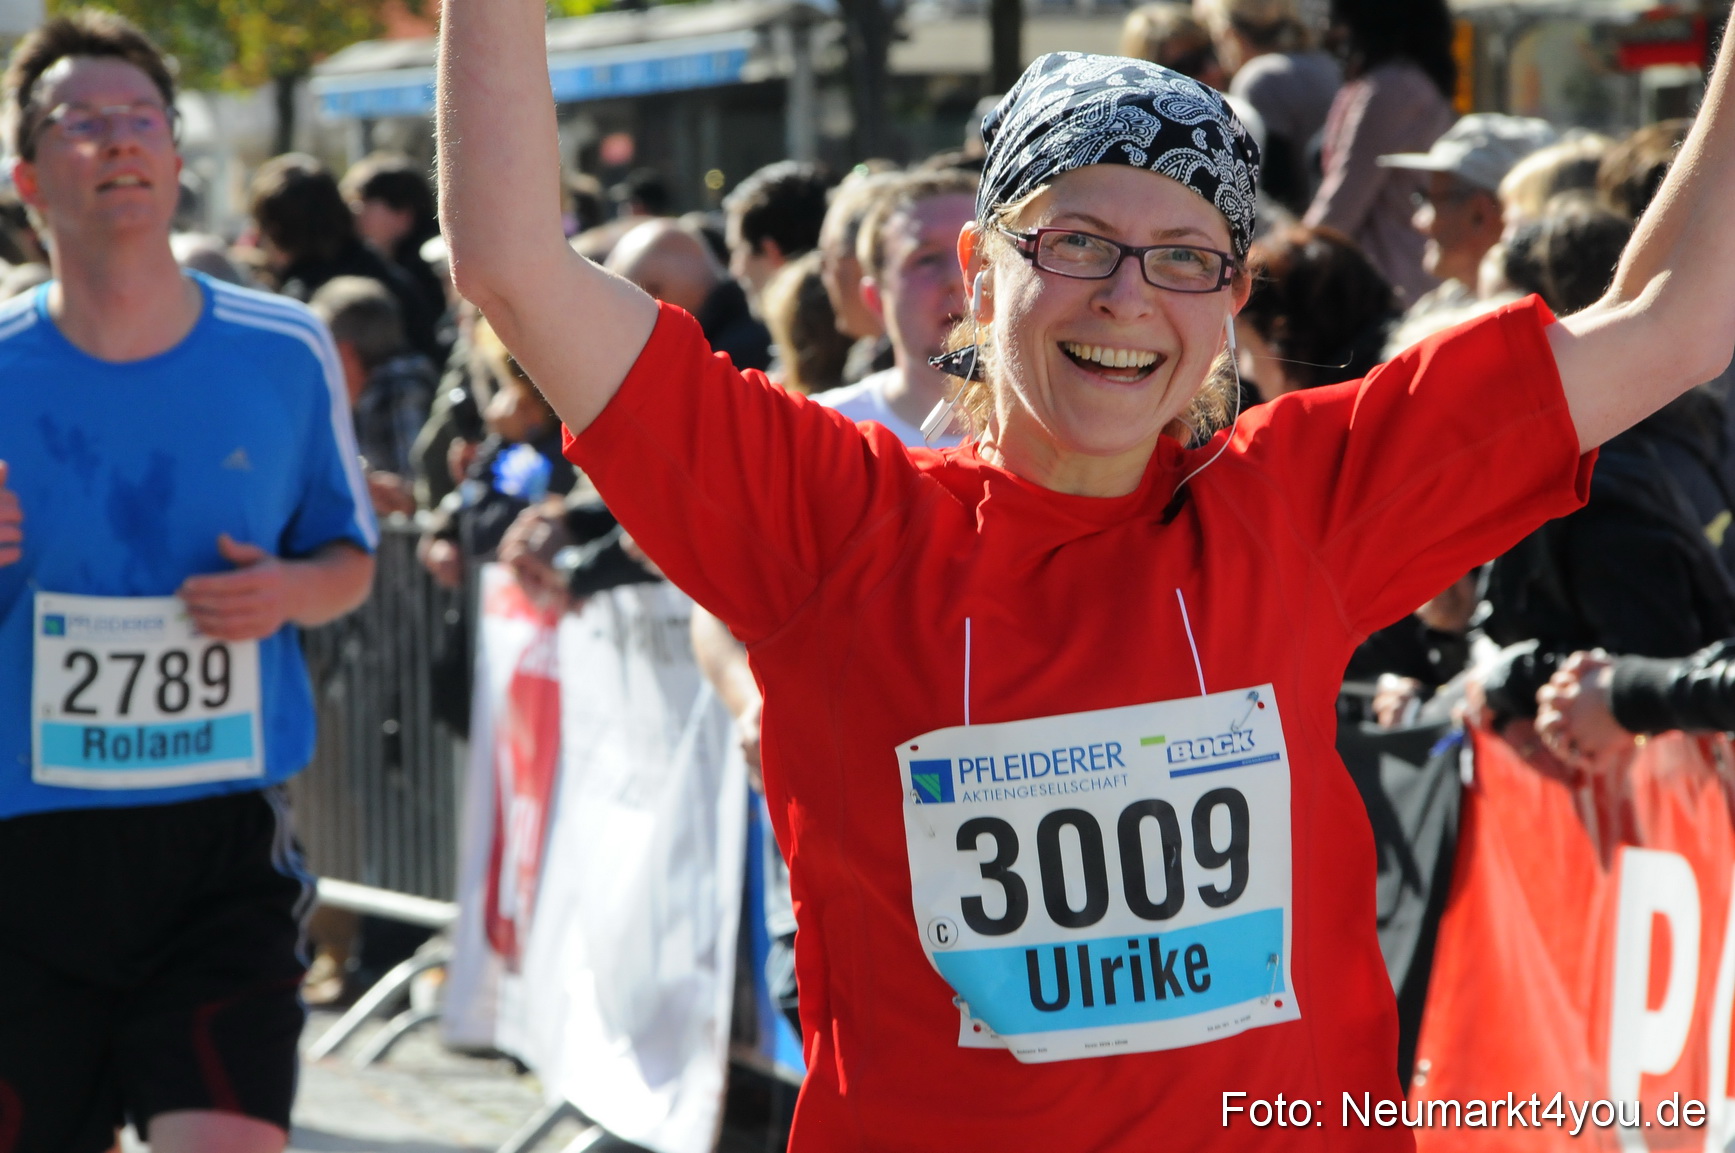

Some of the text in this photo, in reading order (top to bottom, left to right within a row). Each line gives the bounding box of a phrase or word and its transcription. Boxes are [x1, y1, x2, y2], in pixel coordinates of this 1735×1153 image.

[62, 642, 230, 716] 2789
[83, 722, 213, 761] Roland
[1167, 729, 1255, 763] BOCK
[958, 742, 1126, 784] PFLEIDERER
[962, 774, 1128, 804] AKTIENGESELLSCHAFT
[956, 787, 1250, 936] 3009
[935, 923, 949, 943] C
[1025, 937, 1212, 1012] Ulrike
[1608, 846, 1735, 1153] P
